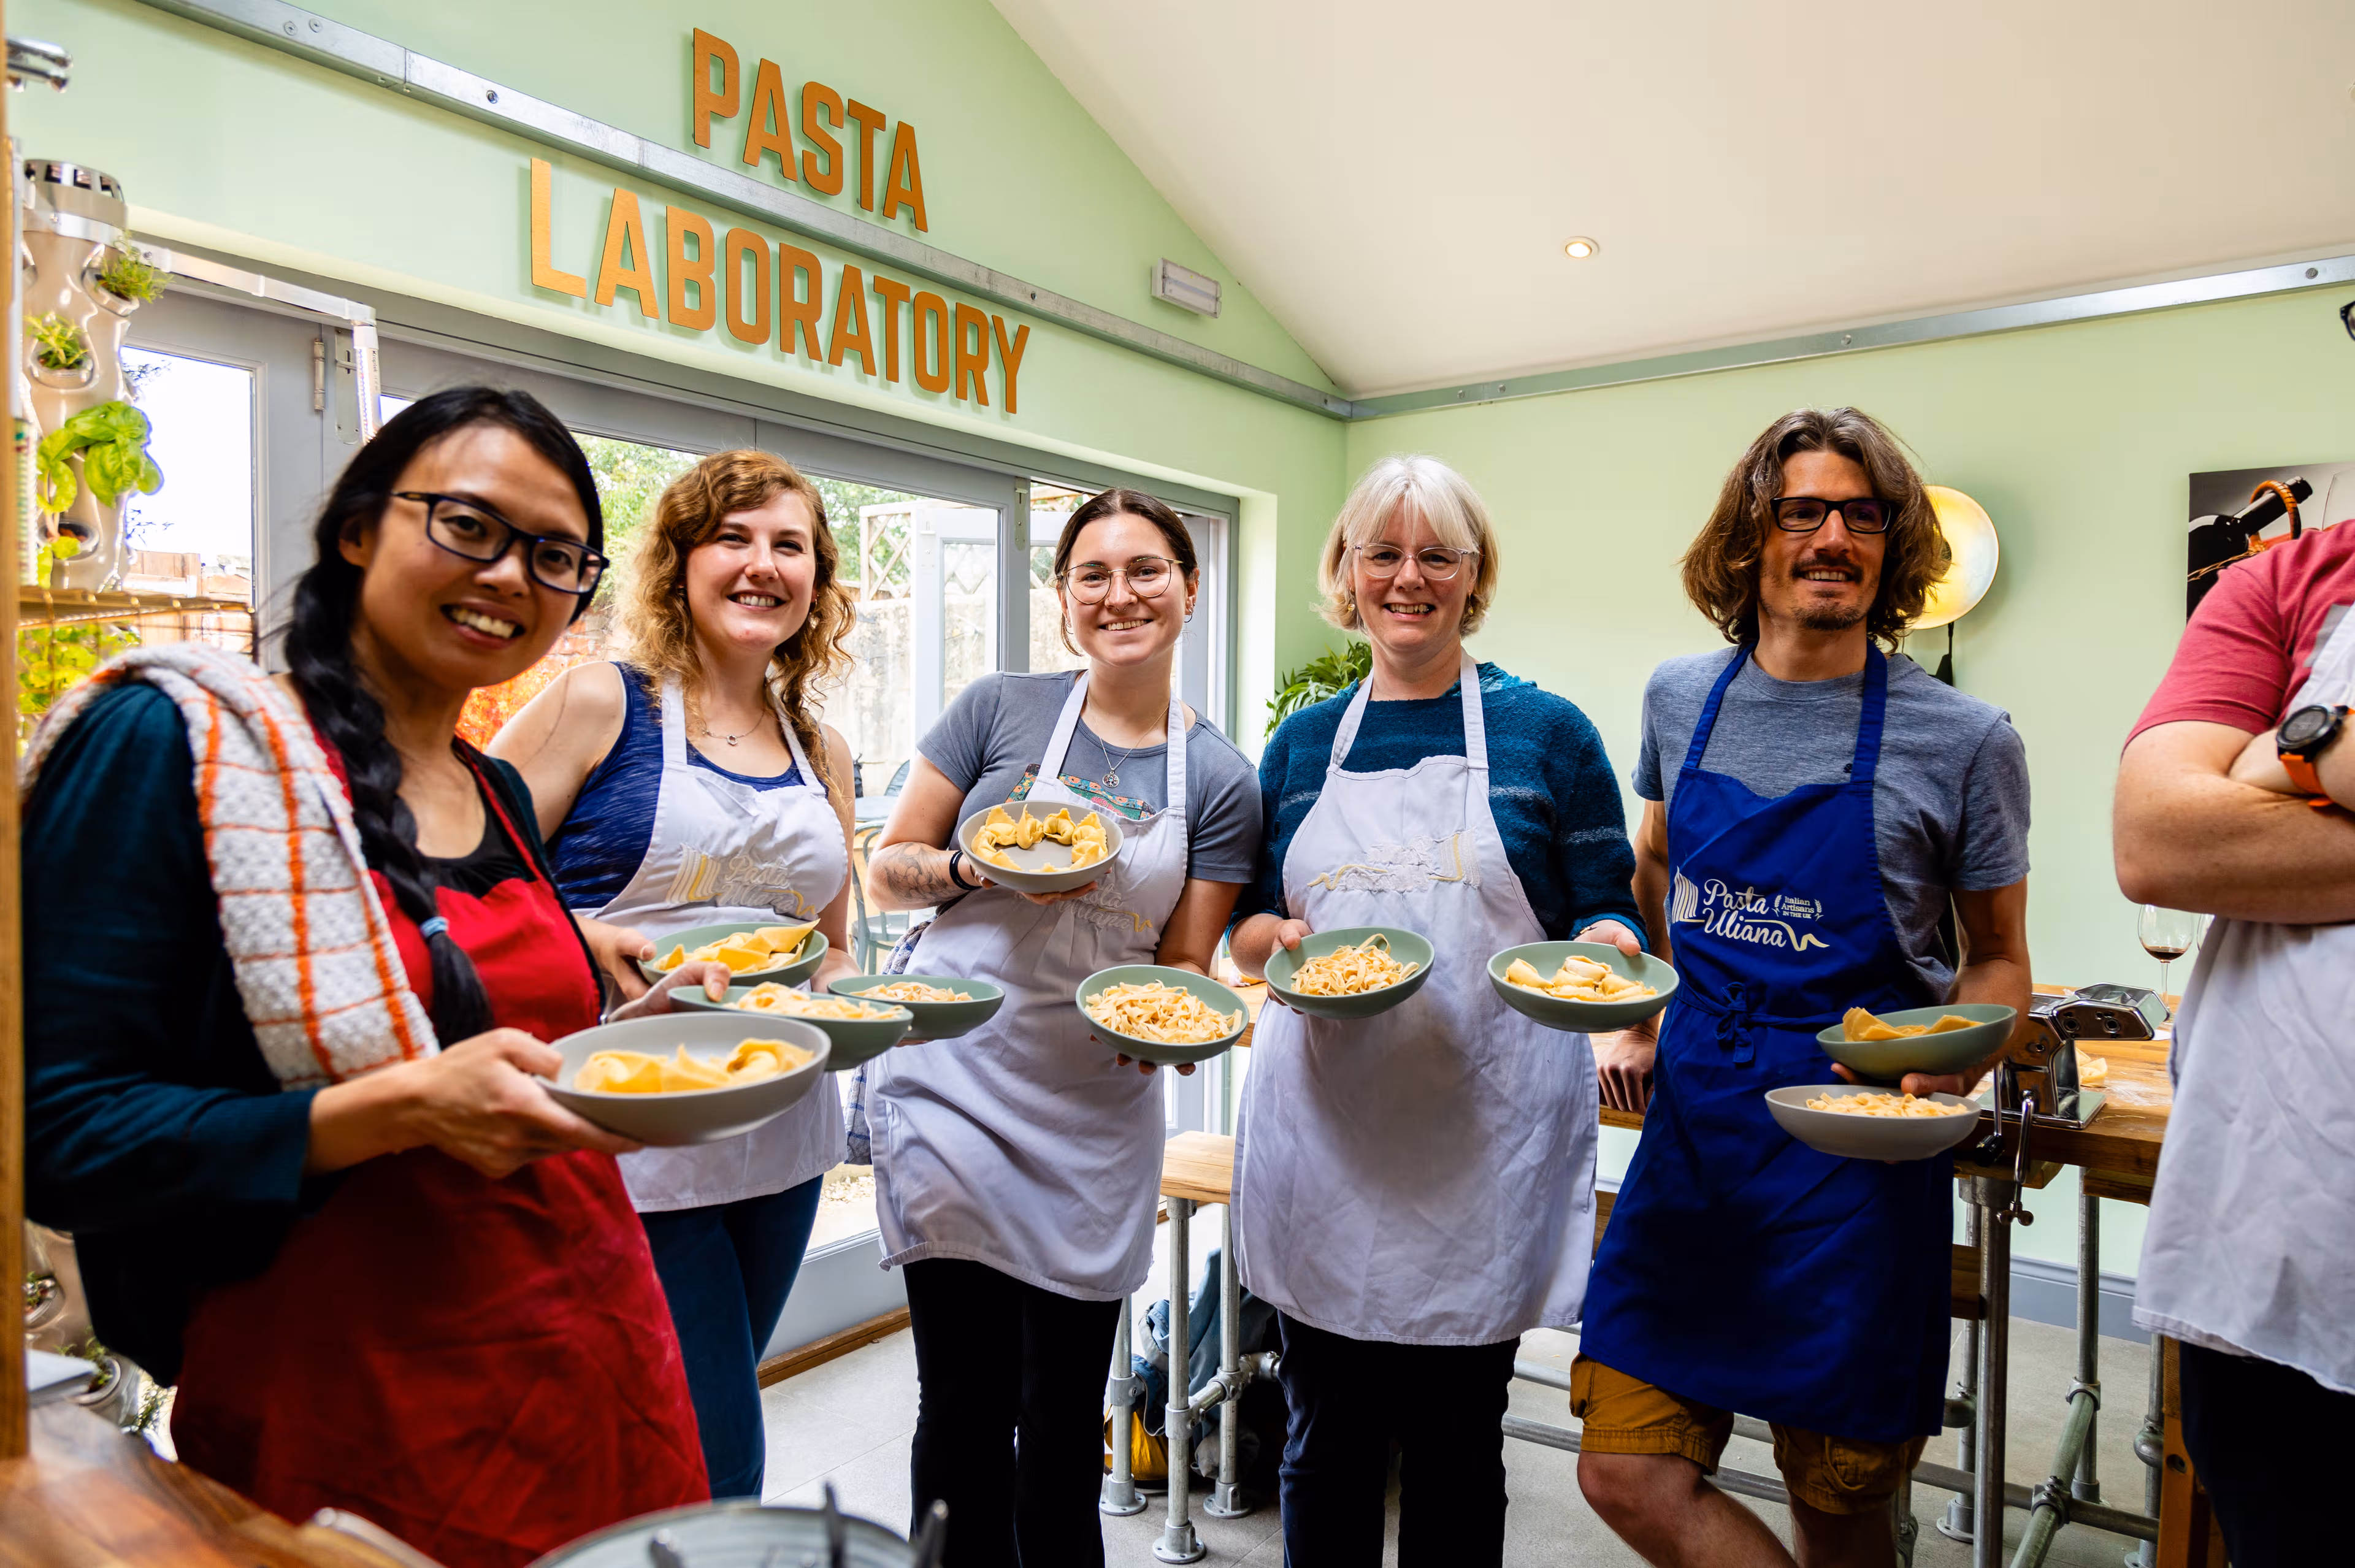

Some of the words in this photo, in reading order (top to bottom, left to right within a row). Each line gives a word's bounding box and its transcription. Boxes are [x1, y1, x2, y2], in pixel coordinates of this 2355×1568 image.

[693, 27, 929, 233] PASTA
[530, 158, 1030, 415] LABORATORY
[724, 853, 790, 889] Pasta
[1703, 879, 1769, 915] Pasta
[1781, 903, 1814, 913] Artisans
[1784, 896, 1810, 906] Italian
[1702, 907, 1787, 947] Uliana
